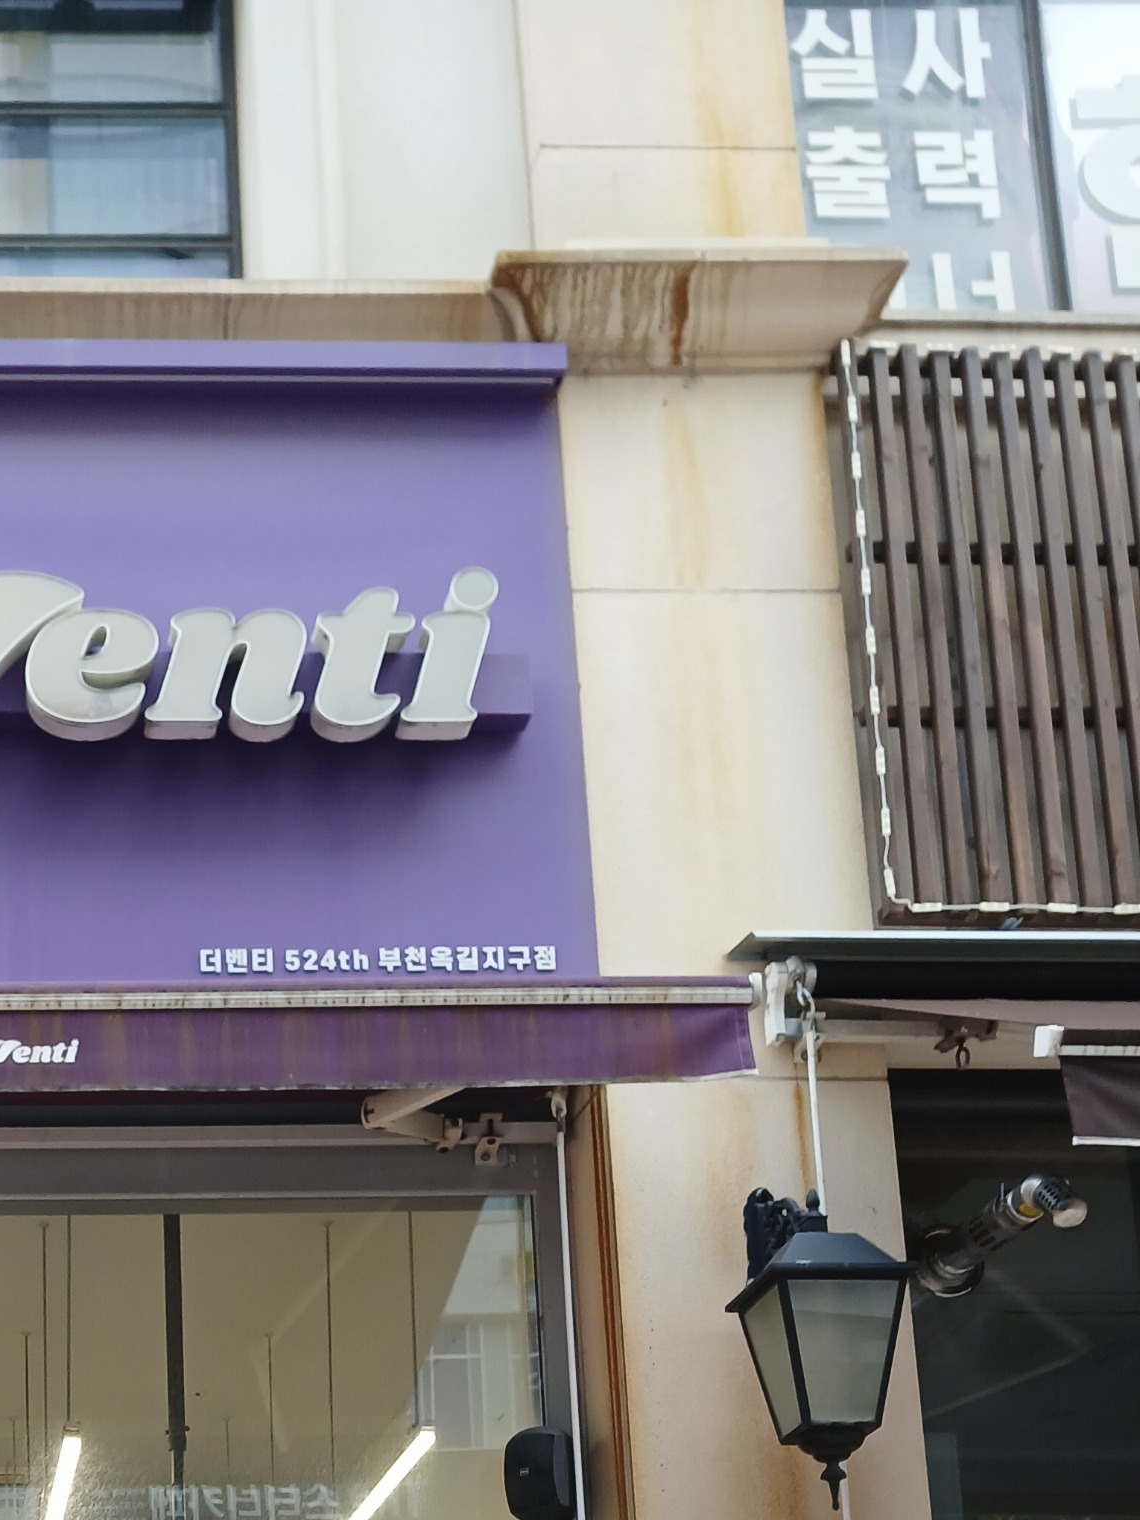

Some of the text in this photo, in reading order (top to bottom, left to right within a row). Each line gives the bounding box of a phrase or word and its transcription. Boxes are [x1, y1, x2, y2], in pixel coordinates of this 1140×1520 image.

[790, 8, 992, 100] 실사
[805, 126, 1001, 219] 출력
[199, 945, 558, 974] 더벤티 524th 부천옥길지구점
